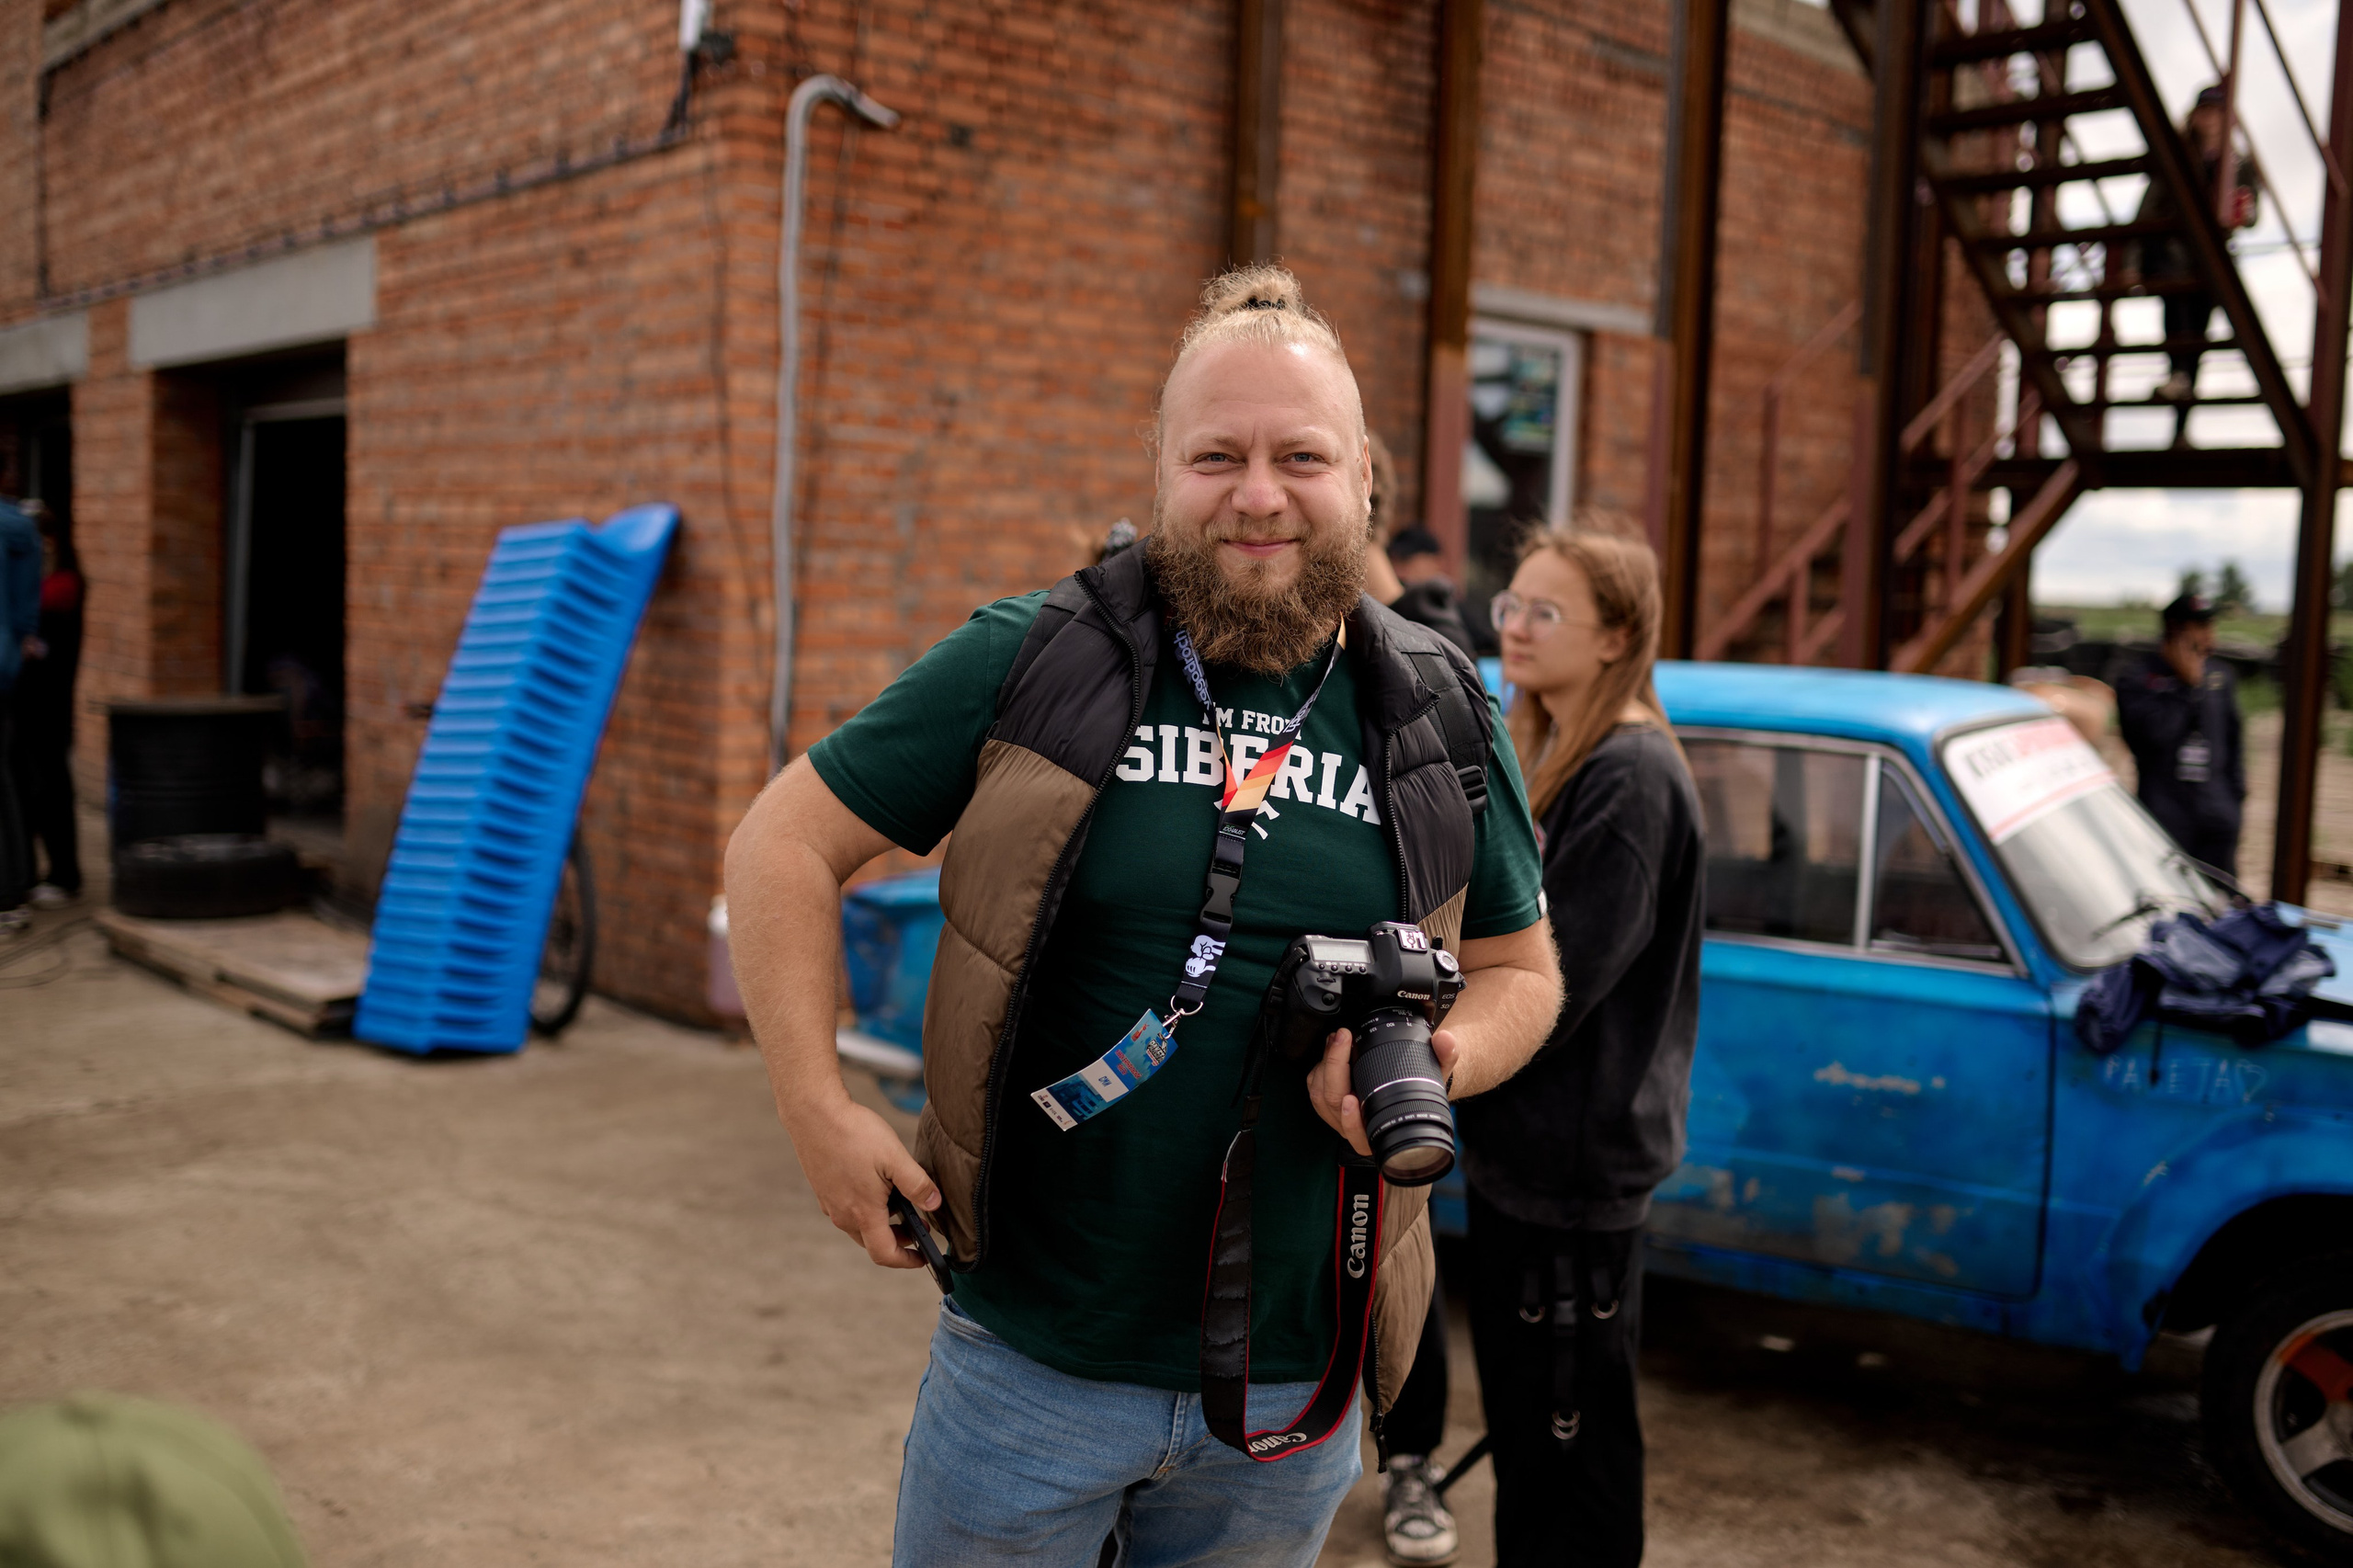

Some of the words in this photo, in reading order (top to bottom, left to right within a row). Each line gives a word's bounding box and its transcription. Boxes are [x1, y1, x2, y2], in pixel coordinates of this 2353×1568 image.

[1115, 724, 1381, 825] SIBERIA
[1397, 990, 1430, 1000] Canon
[1347, 1194, 1370, 1278] Canon
